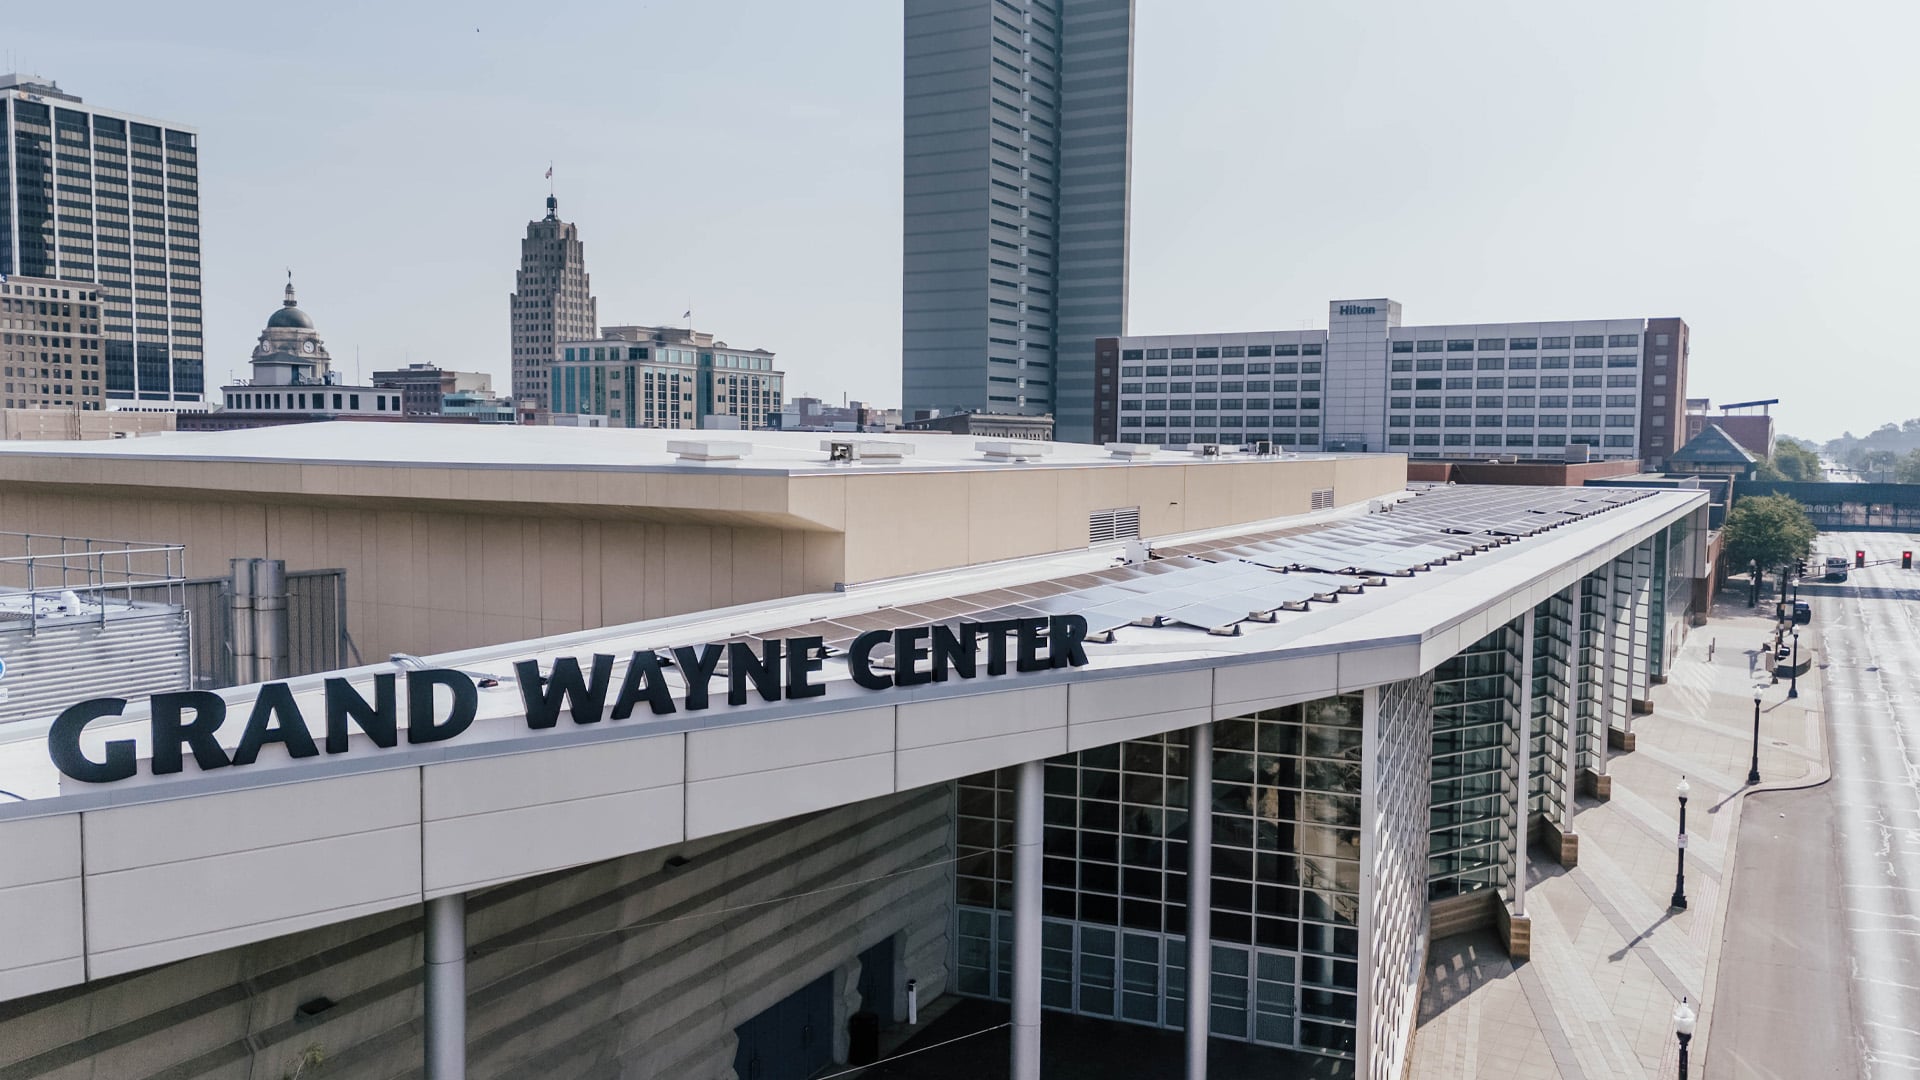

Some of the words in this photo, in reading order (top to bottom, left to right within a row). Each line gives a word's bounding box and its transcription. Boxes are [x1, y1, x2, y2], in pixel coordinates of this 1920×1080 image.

[1339, 304, 1376, 315] Hilton
[48, 668, 479, 784] GRAND
[513, 636, 826, 730] WAYNE
[848, 614, 1090, 691] CENTER
